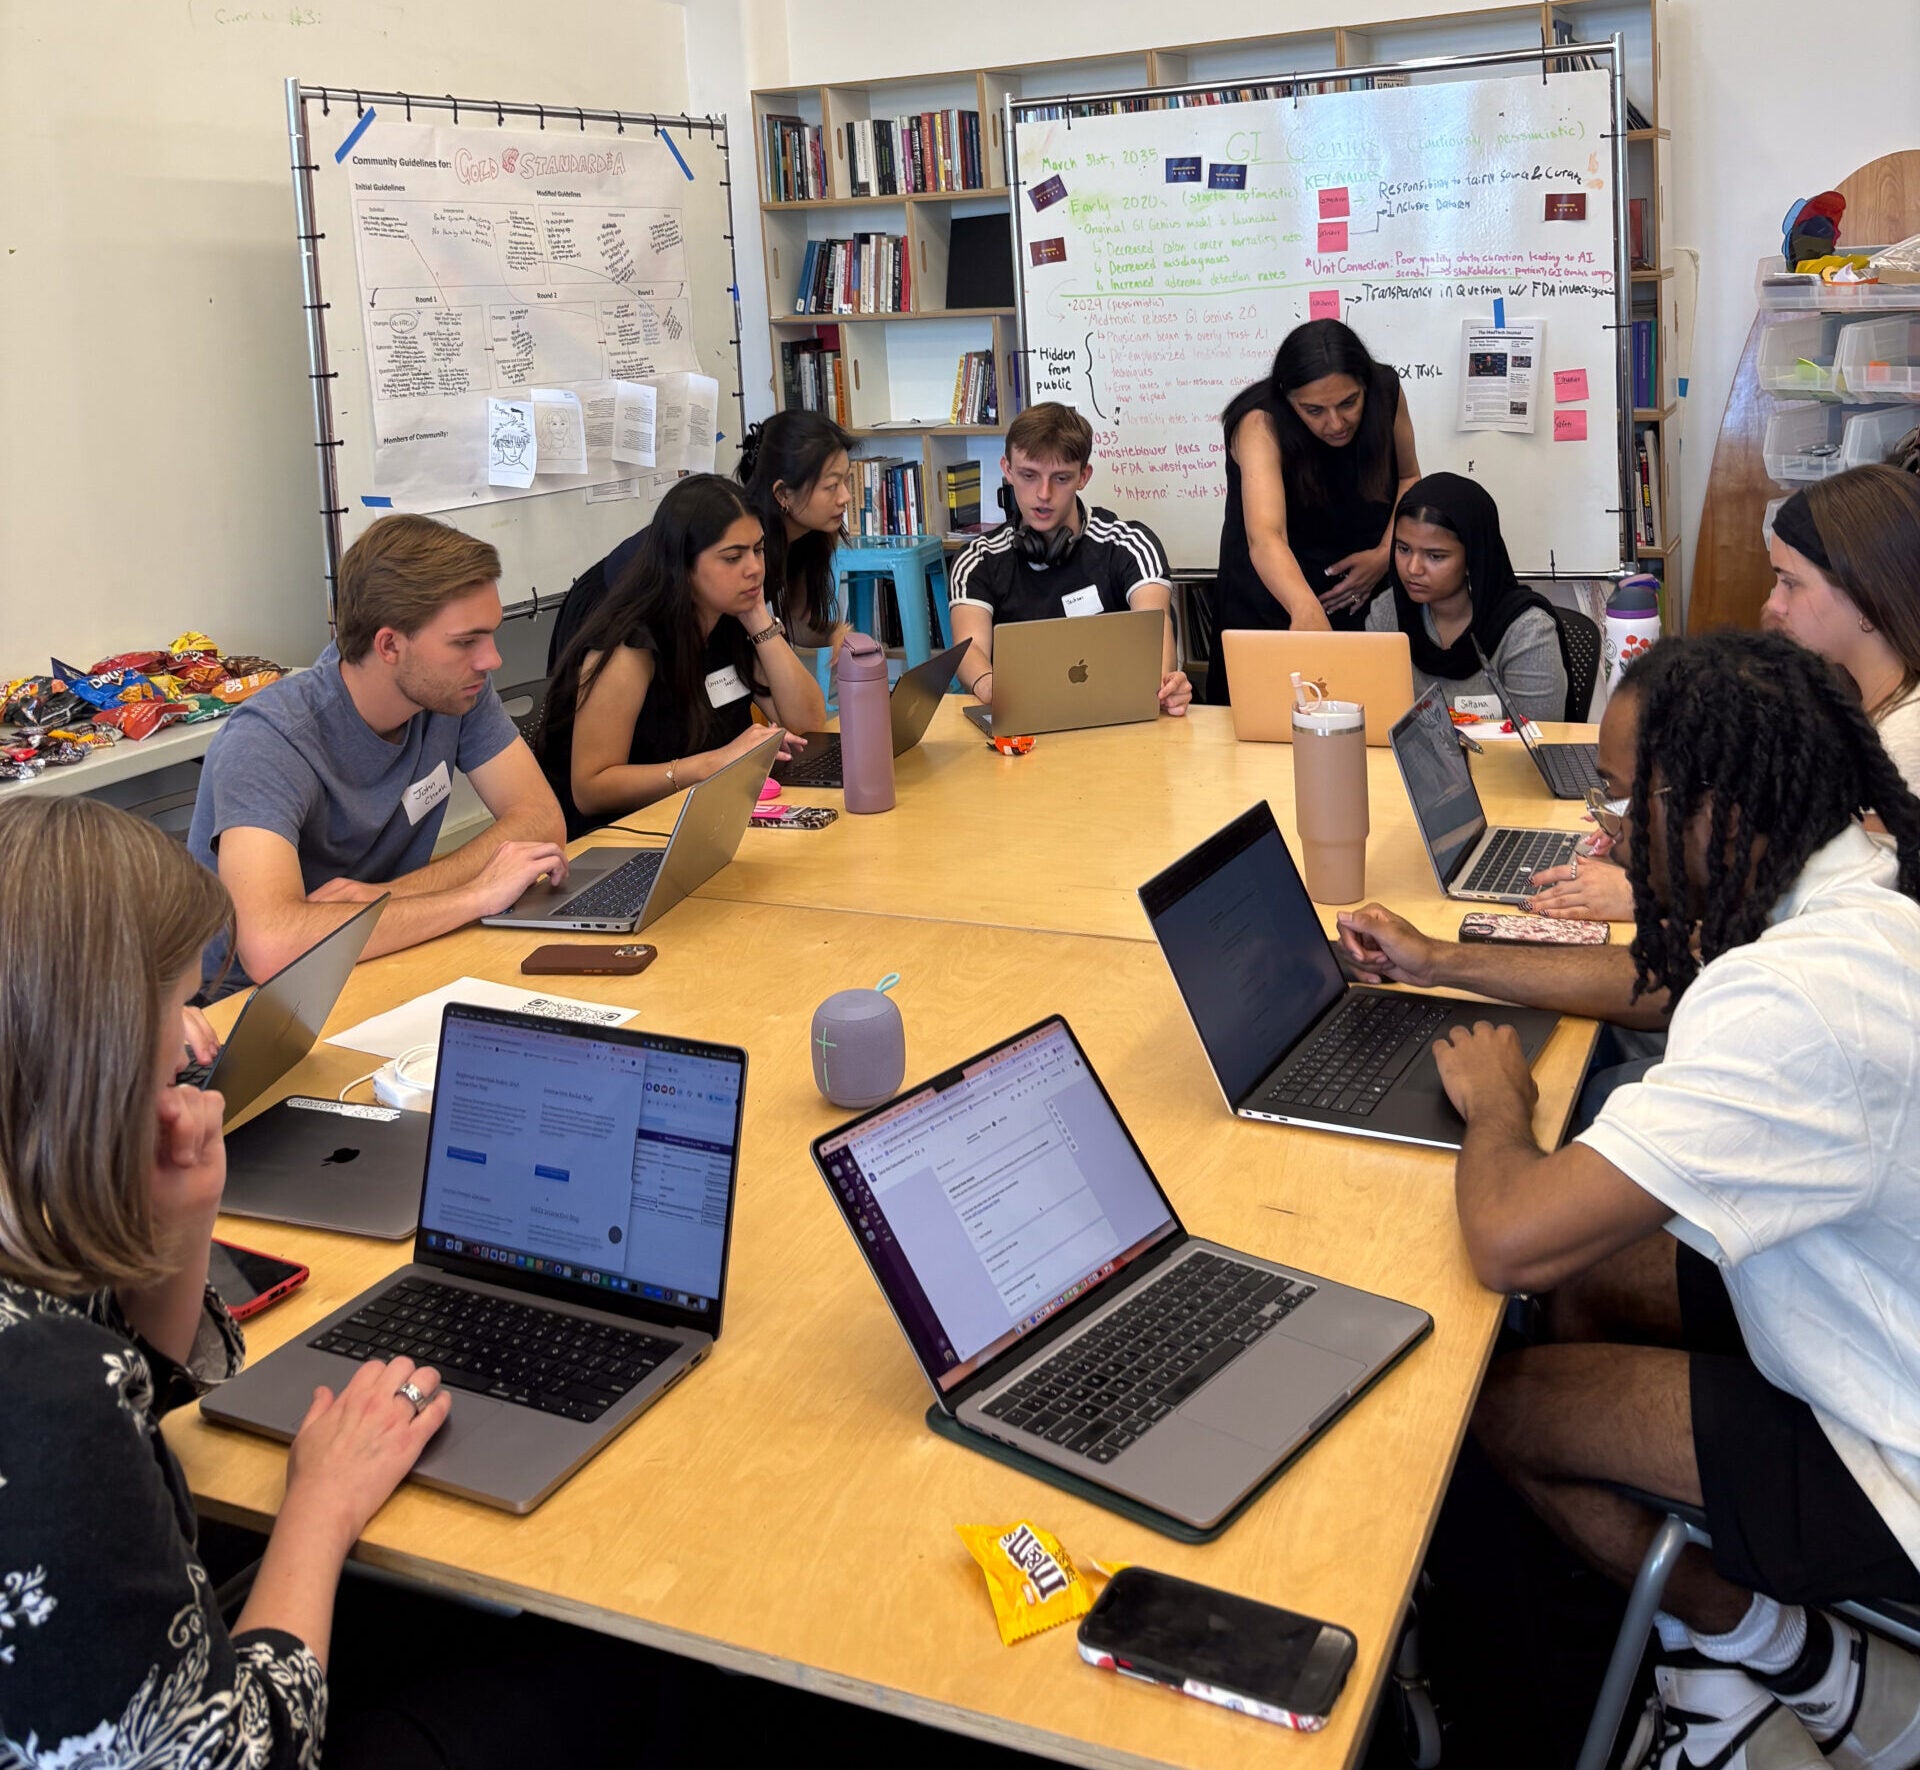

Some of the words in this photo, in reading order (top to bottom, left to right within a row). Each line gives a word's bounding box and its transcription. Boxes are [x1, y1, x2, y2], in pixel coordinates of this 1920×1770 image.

[1226, 130, 1262, 162] GI
[352, 156, 397, 169] Community
[399, 158, 437, 169] Guidelines
[438, 158, 452, 170] for:
[1042, 156, 1077, 172] March
[1123, 149, 1159, 164] 2035
[355, 183, 373, 193] Initial
[374, 183, 406, 193] Guidelines
[536, 190, 558, 198] Modified
[559, 190, 582, 199] Guidelines
[1070, 198, 1111, 217] Early
[1235, 187, 1298, 207] optimistic)
[1084, 223, 1124, 236] Original
[1149, 217, 1181, 231] Genius
[1106, 240, 1153, 257] Decreased
[1193, 238, 1224, 252] cancer
[1109, 256, 1156, 274] Decreased
[1395, 250, 1417, 266] Poor
[1564, 253, 1575, 262] to
[1578, 251, 1595, 263] AI
[1110, 276, 1154, 290] Increased
[1257, 269, 1287, 282] rates
[1440, 284, 1453, 299] in
[1532, 281, 1556, 298] FDA
[1088, 313, 1137, 327] Medtronic
[1142, 313, 1178, 325] releases
[1203, 308, 1233, 323] Genius
[1039, 347, 1076, 361] Hidden
[1048, 363, 1071, 377] from
[1036, 379, 1072, 393] public
[384, 432, 407, 444] Members
[408, 433, 415, 442] of
[416, 430, 449, 443] Community:
[1093, 431, 1119, 447] 035
[1120, 461, 1144, 475] FDA
[1149, 459, 1218, 479] investigation
[413, 781, 436, 801] John
